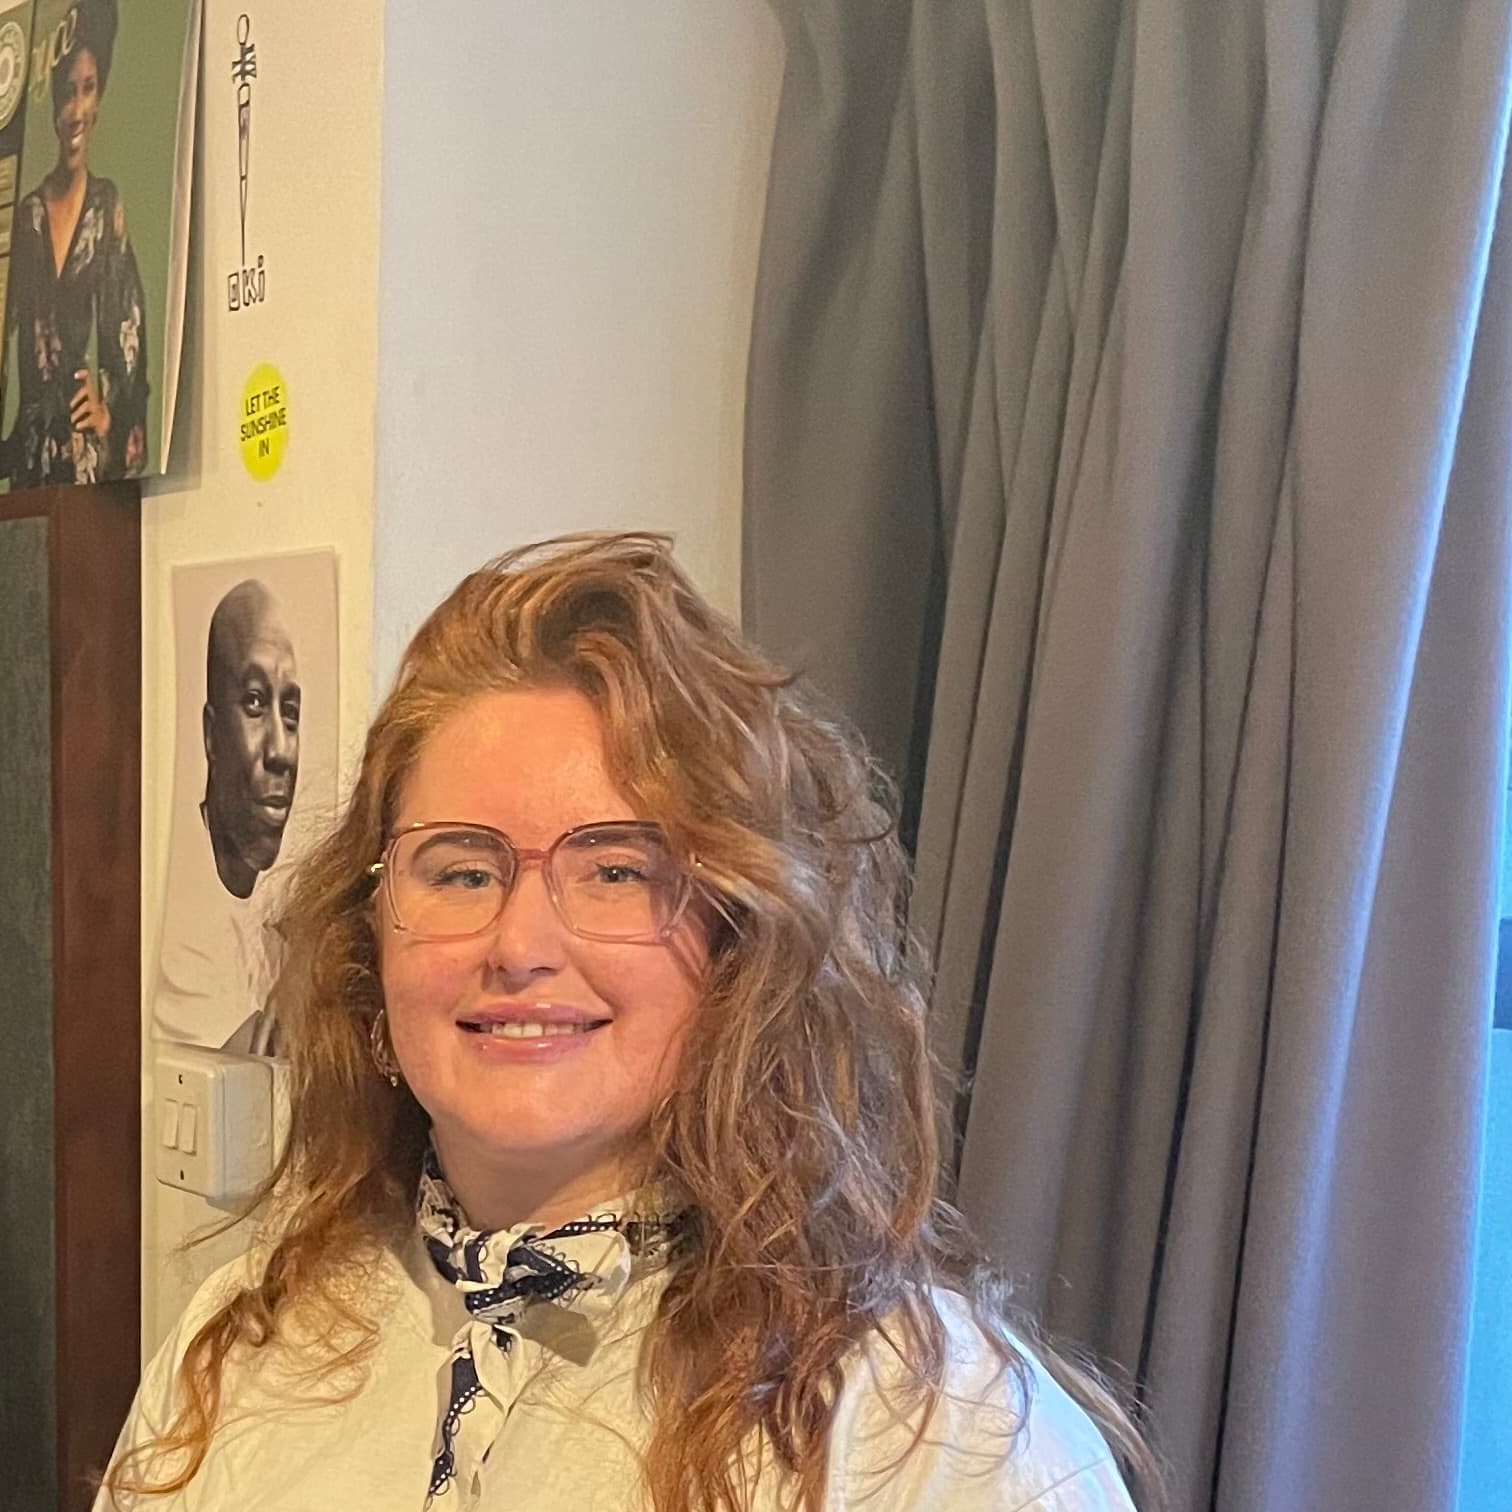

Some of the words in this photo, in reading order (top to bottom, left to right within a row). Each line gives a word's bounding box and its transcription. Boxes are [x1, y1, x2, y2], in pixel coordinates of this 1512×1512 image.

[246, 394, 261, 416] LET
[262, 386, 280, 411] THE
[240, 407, 287, 441] SUNSHINE
[259, 438, 270, 458] IN
